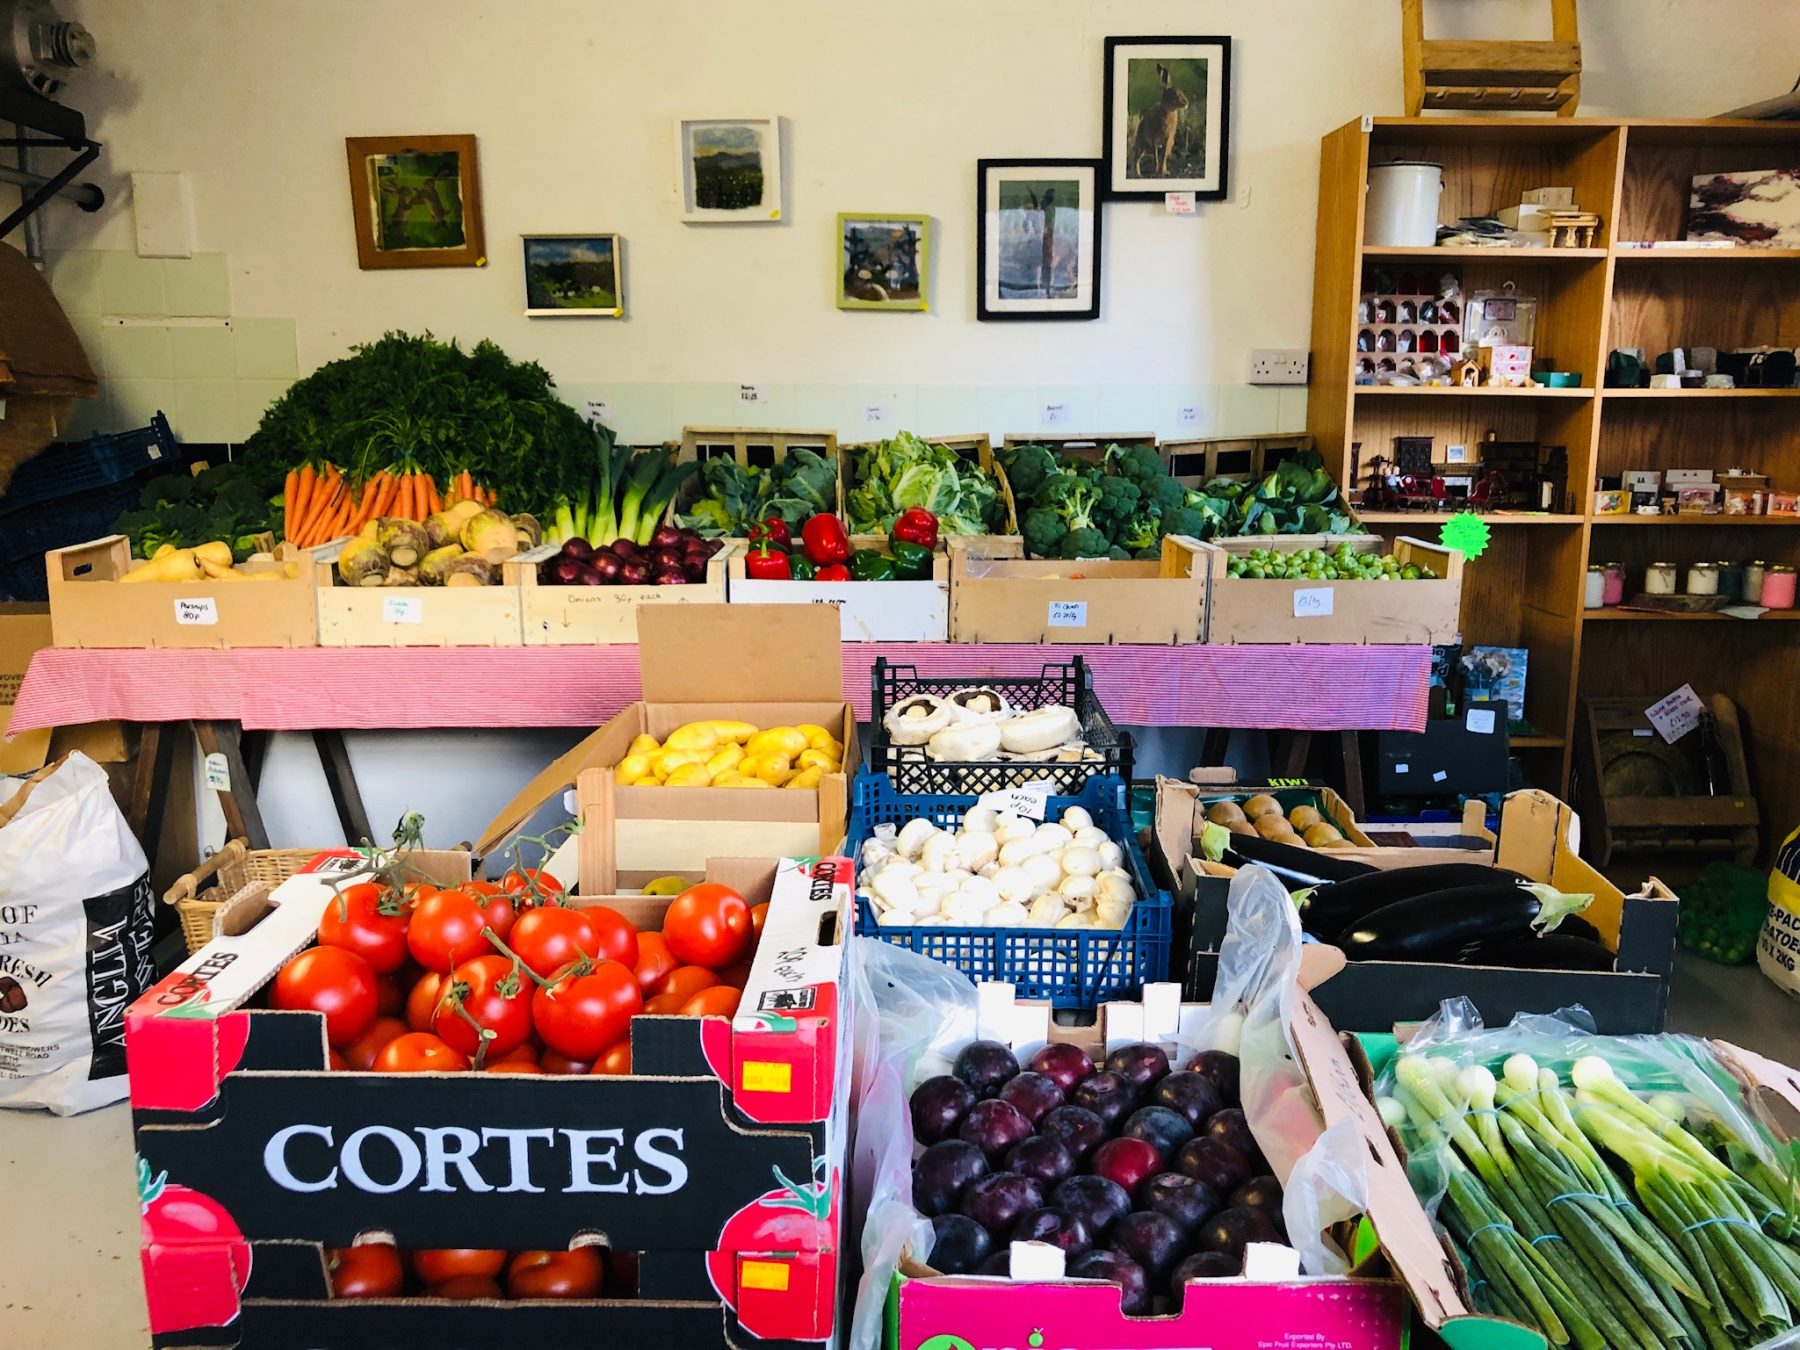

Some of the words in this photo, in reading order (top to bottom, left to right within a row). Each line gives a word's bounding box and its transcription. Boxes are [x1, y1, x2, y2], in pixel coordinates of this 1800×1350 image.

[640, 593, 662, 601] each
[183, 611, 200, 621] 80p
[1267, 778, 1309, 788] KIWI
[808, 861, 837, 901] CORTES
[1, 904, 38, 925] OF
[91, 915, 130, 1047] ANGLIA
[157, 951, 239, 1006] CORTES
[262, 1123, 689, 1196] CORTES
[1284, 1333, 1314, 1341] Exported
[1315, 1333, 1325, 1342] By
